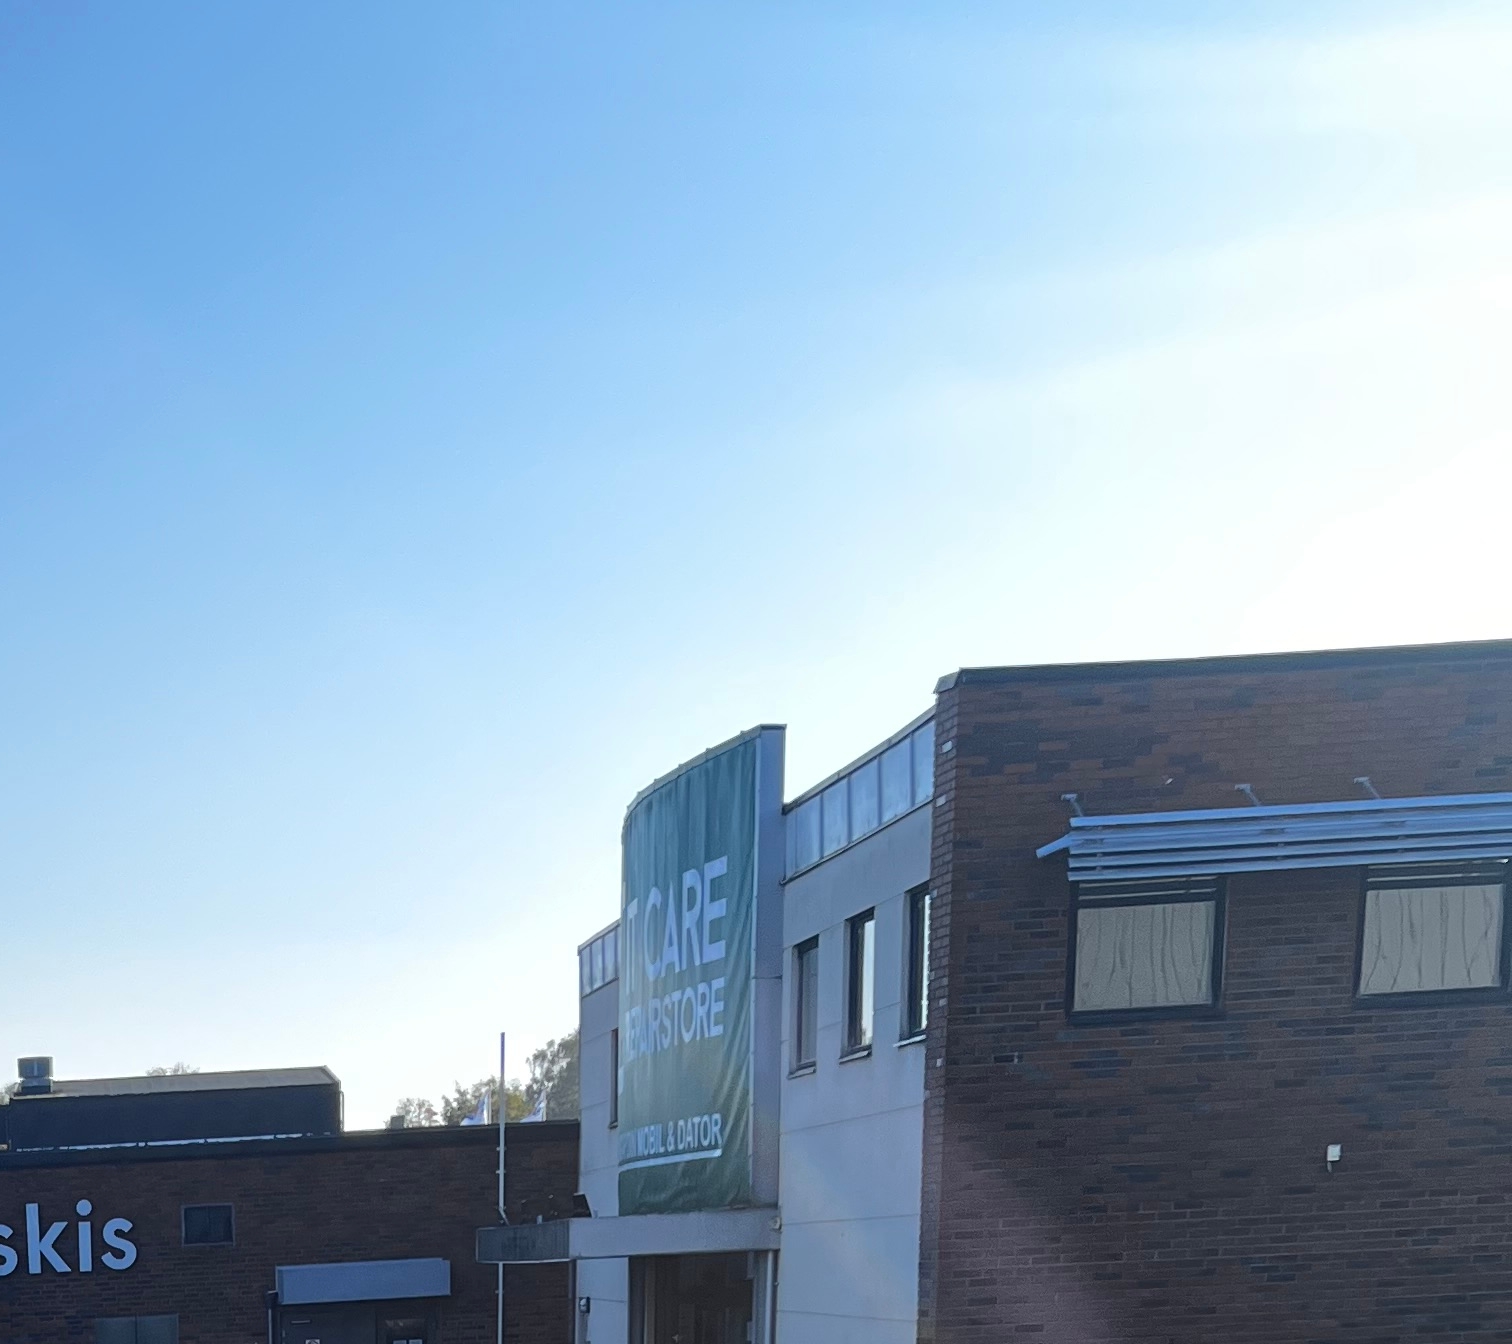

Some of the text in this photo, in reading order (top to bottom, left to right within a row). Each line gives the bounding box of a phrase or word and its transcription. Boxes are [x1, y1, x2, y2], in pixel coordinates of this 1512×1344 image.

[644, 855, 728, 982] CARE
[666, 1120, 676, 1153] &
[677, 1112, 723, 1150] DATOR
